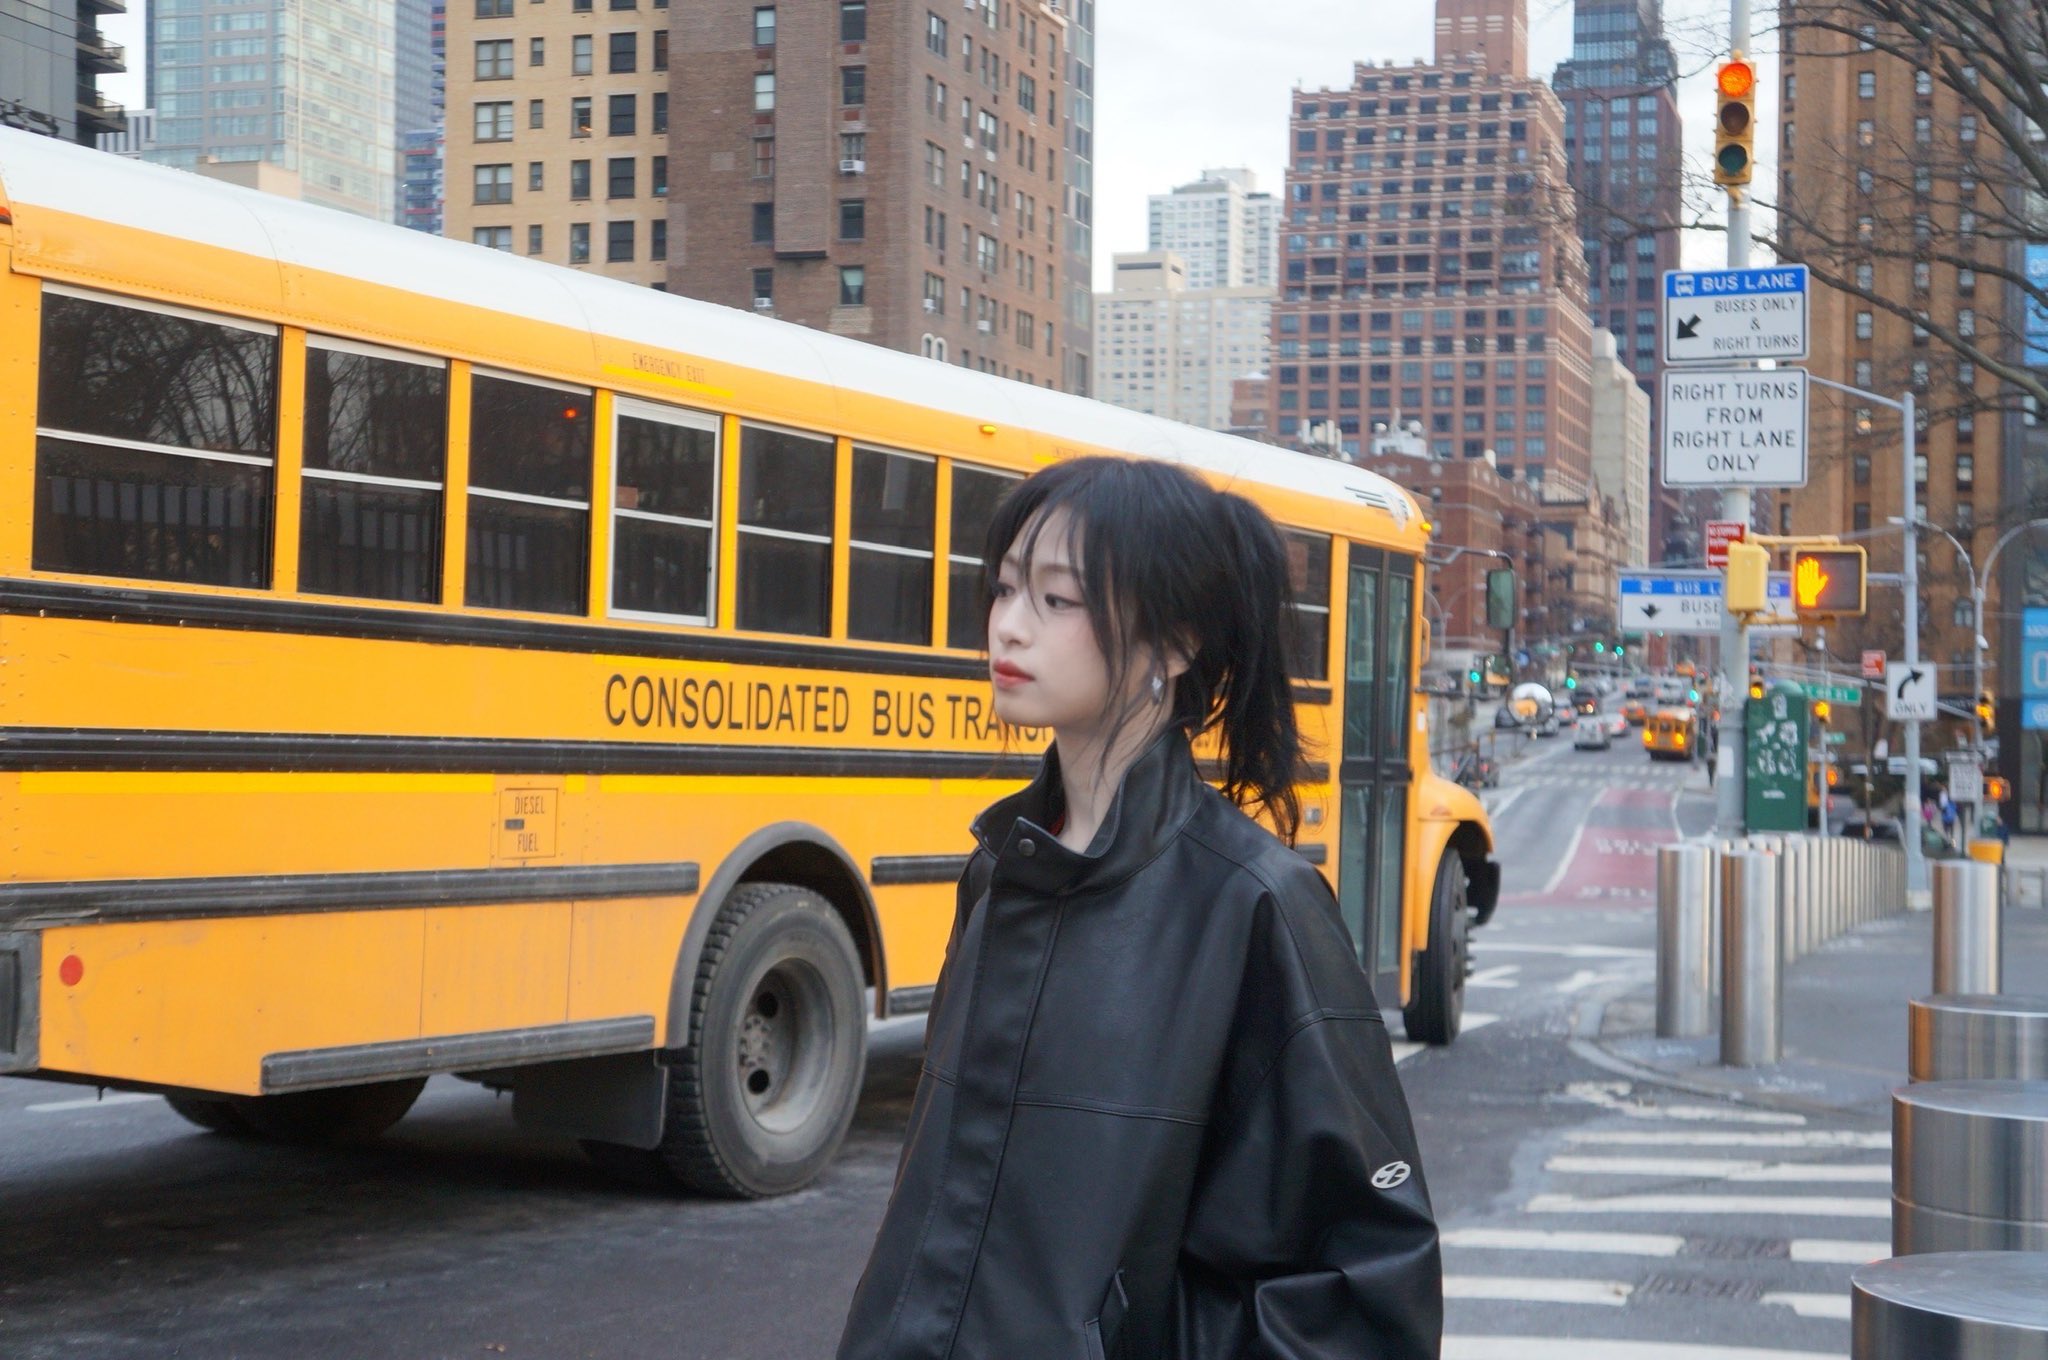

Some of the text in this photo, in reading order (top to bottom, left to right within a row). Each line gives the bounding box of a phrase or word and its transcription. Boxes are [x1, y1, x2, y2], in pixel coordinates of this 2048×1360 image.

[1701, 272, 1797, 292] BUS LANE
[1714, 297, 1798, 313] BUSES ONLY
[1713, 334, 1799, 350] RIGHT TURNS
[1672, 382, 1798, 401] RIGHT TURNS
[1706, 407, 1763, 425] FROM
[1672, 429, 1797, 449] RIGHT LANE
[1706, 454, 1760, 472] ONLY
[1674, 580, 1701, 594] BUS
[605, 673, 849, 734] CONSOLIDATED
[872, 689, 935, 739] BUS
[514, 795, 545, 815] DIESEL
[517, 832, 539, 852] FUEL
